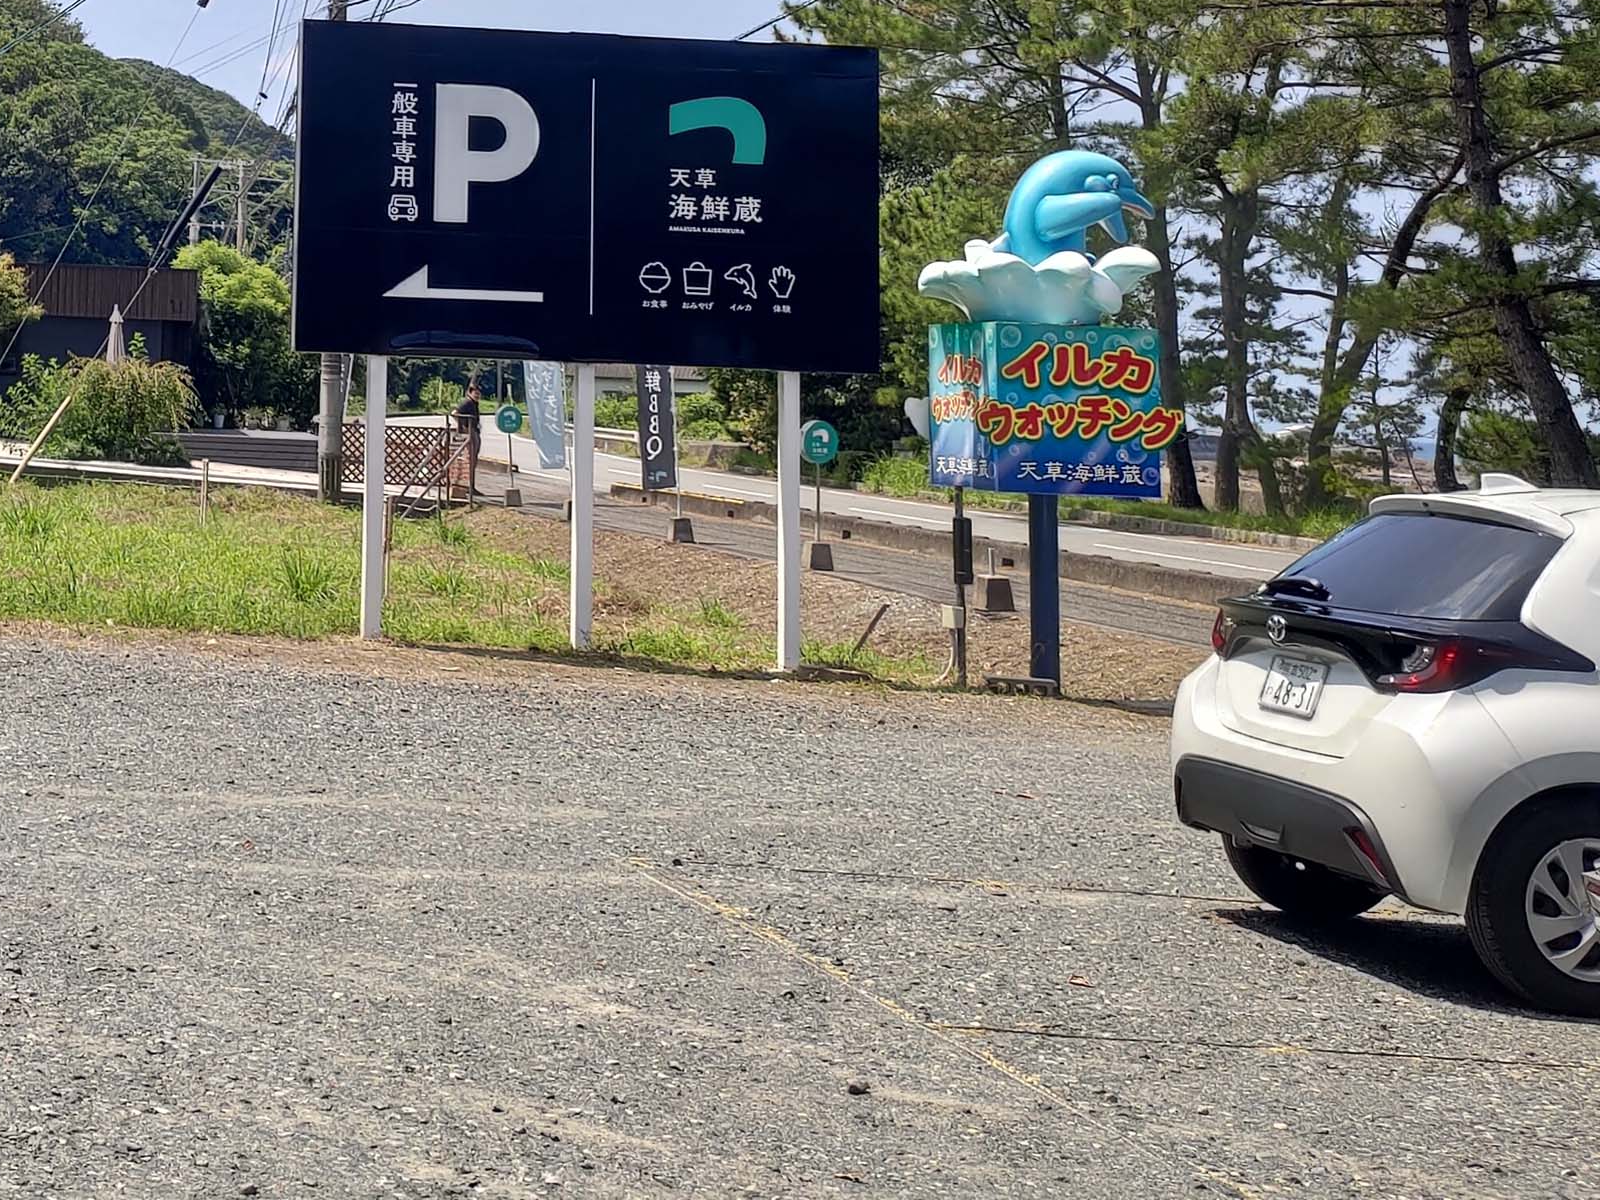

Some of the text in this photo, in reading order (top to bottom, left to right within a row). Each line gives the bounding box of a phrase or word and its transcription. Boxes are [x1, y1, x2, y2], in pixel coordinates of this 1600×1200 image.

[391, 82, 418, 188] 一般車専用
[433, 82, 540, 223] P
[668, 168, 717, 189] 天草
[668, 194, 763, 223] 海鮮蔵
[682, 302, 714, 311] おみやげ
[729, 304, 752, 312] イルカ
[938, 354, 983, 386] イルカ
[1001, 341, 1154, 393] イルカ
[977, 395, 1184, 449] ウォッチング
[1016, 461, 1145, 485] 天草海鮮蔵
